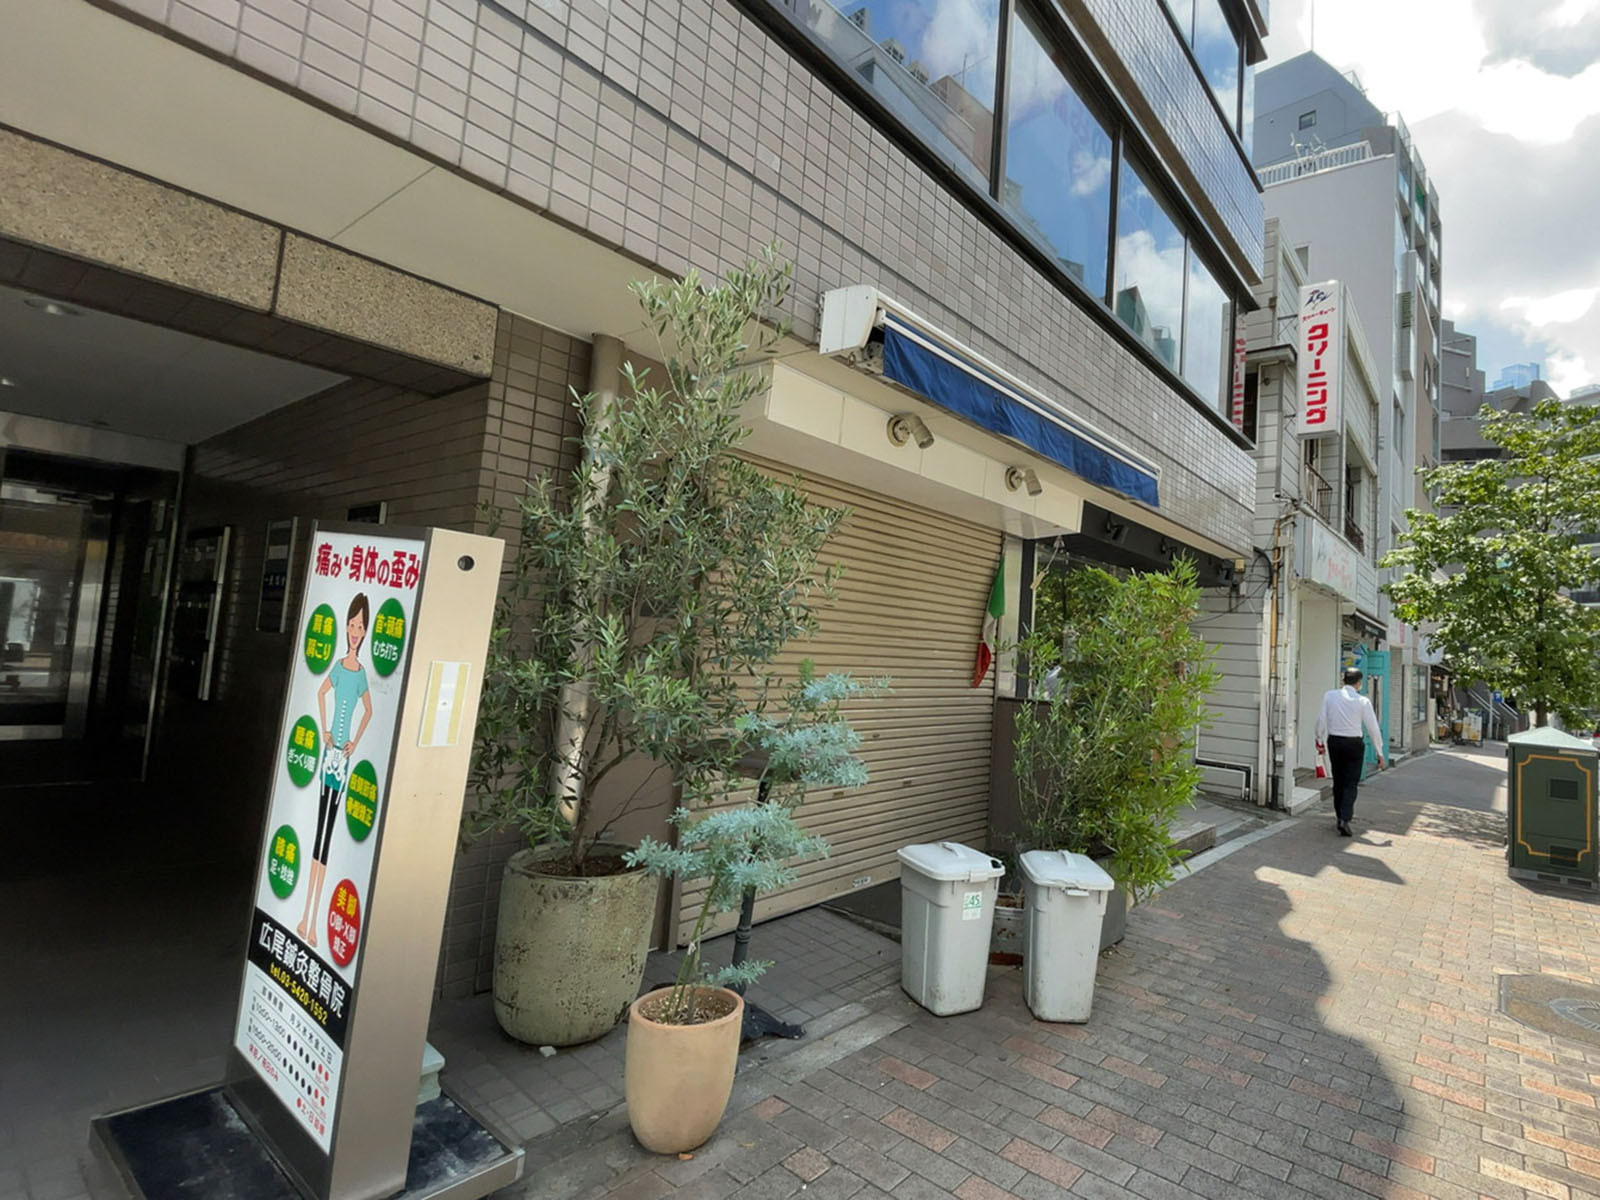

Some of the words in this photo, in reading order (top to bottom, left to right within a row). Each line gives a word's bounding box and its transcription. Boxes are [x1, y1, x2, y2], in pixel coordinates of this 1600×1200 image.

[1306, 323, 1328, 424] クリーニング
[315, 542, 420, 590] 痛み・身体の歪み
[373, 640, 398, 661] むち打ち
[258, 921, 345, 1018] 広尾鍼灸整骨院
